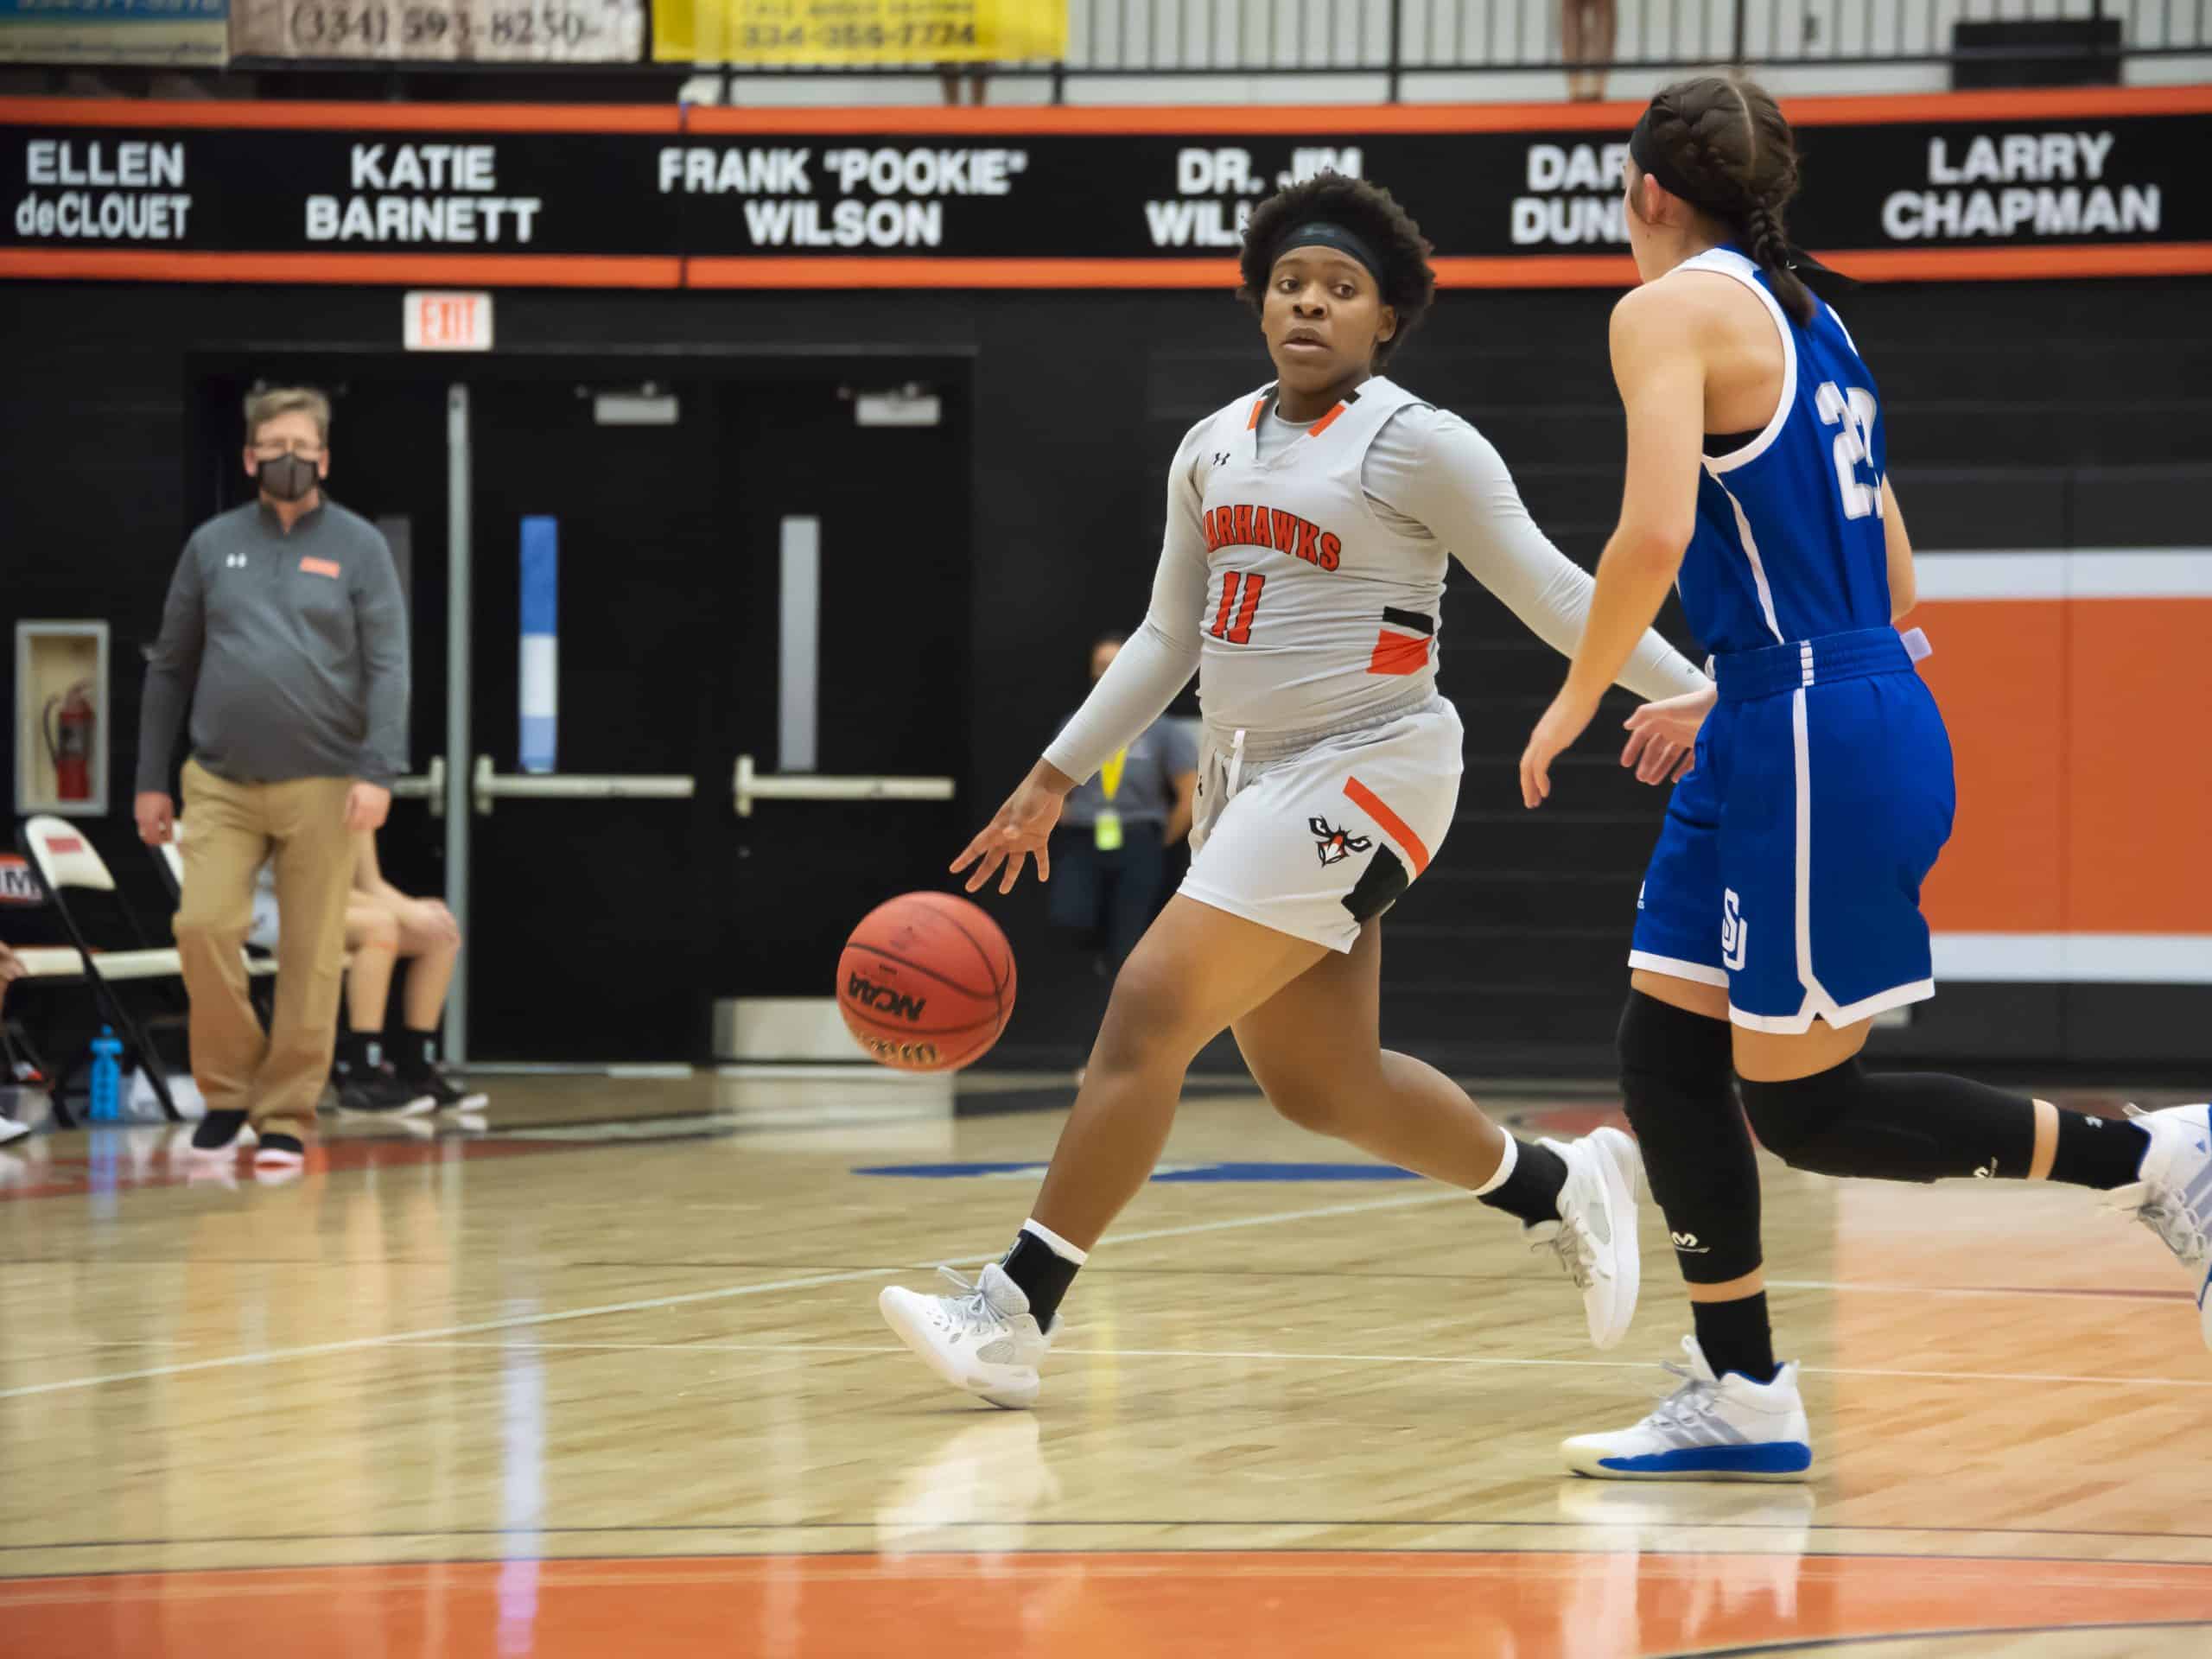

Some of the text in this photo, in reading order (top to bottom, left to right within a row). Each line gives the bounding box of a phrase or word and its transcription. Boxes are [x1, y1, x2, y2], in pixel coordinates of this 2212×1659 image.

[28, 142, 184, 187] ELLEN
[353, 145, 495, 191] KATIE
[659, 149, 1027, 195] FRANK "POOKIE"
[1178, 148, 1265, 194] DR.
[1929, 133, 2113, 184] LARRY
[16, 194, 191, 238] deCLOUET
[307, 196, 541, 242] BARNETT
[745, 200, 943, 246] WILSON
[1882, 184, 2160, 239] CHAPMAN
[421, 297, 476, 345] EXIT
[1202, 505, 1341, 571] ARHAWKS
[1211, 571, 1265, 645] 11
[849, 969, 926, 1022] NCAA
